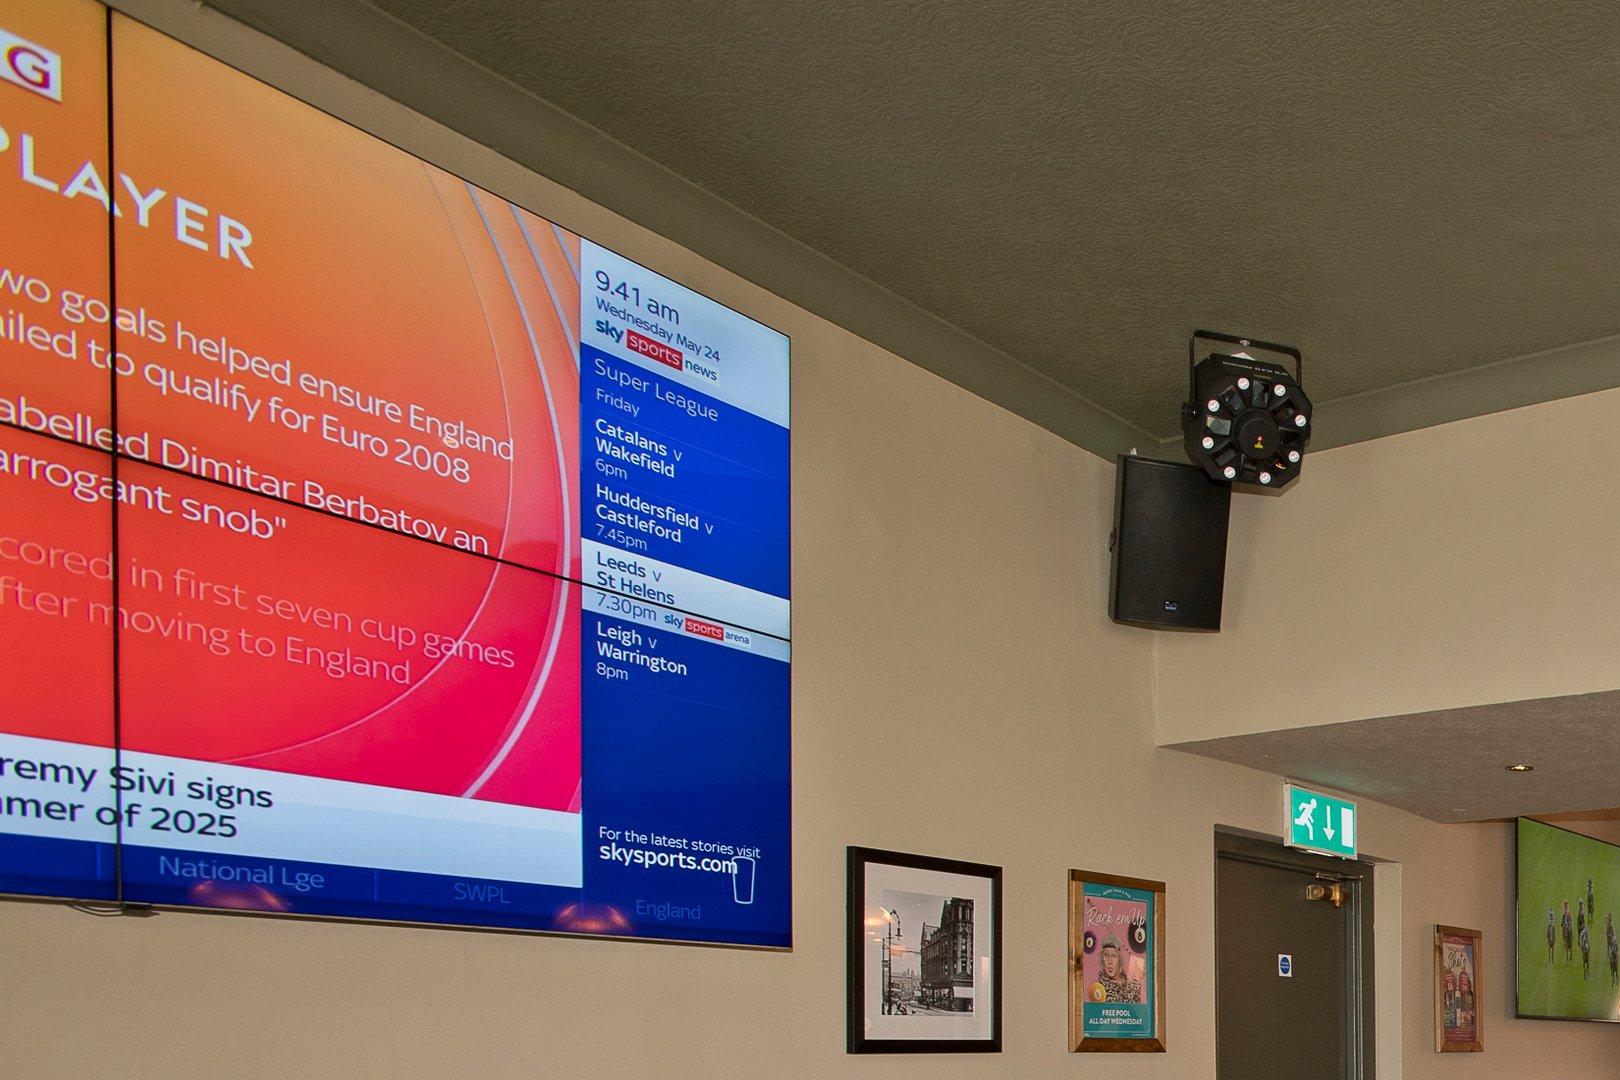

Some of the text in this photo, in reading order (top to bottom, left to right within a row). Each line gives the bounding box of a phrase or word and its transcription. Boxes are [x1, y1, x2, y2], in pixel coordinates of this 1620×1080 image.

[595, 270, 680, 325] 9.41 am
[595, 296, 721, 362] Wednesday May 24
[595, 320, 718, 381] sky sports news
[61, 290, 167, 343] goals
[176, 321, 291, 386] helped
[300, 373, 402, 425] ensure
[409, 406, 514, 462] England
[594, 358, 719, 422] Super League
[0, 310, 471, 484] iled to qualify for Euro 2008
[595, 387, 640, 418] Friday
[595, 418, 668, 457] Catalans
[595, 436, 675, 478] Wakefield
[595, 457, 627, 480] 6pm
[162, 437, 297, 501] Dimitar
[304, 479, 447, 543] Berbatov
[454, 532, 489, 557] an
[596, 483, 699, 531] Huddersfield
[181, 497, 287, 539] snob"
[595, 504, 682, 543] Castleford
[595, 523, 648, 551] 7.45pm
[597, 550, 647, 578] Leeds
[597, 571, 675, 605] St Helens
[132, 557, 163, 592] in
[174, 568, 248, 610] first
[256, 594, 352, 633] seven
[361, 616, 417, 650] cup
[423, 631, 515, 669] games
[596, 591, 750, 645] 7.30pm sky sports arena
[89, 601, 230, 656] moving
[239, 626, 276, 657] to
[286, 637, 411, 685] England
[597, 621, 642, 647] Leigh
[596, 662, 628, 681] 8pm
[597, 640, 687, 675] Warrington
[110, 766, 175, 797] Sivi
[187, 776, 274, 811] signs
[0, 795, 238, 838] mer of 2025
[599, 826, 761, 859] For the latest stories visit
[599, 842, 738, 875] skysports.com
[159, 855, 325, 890] National Lge
[454, 882, 510, 905] SWPL
[635, 900, 701, 921] England
[1086, 905, 1114, 927] Rack
